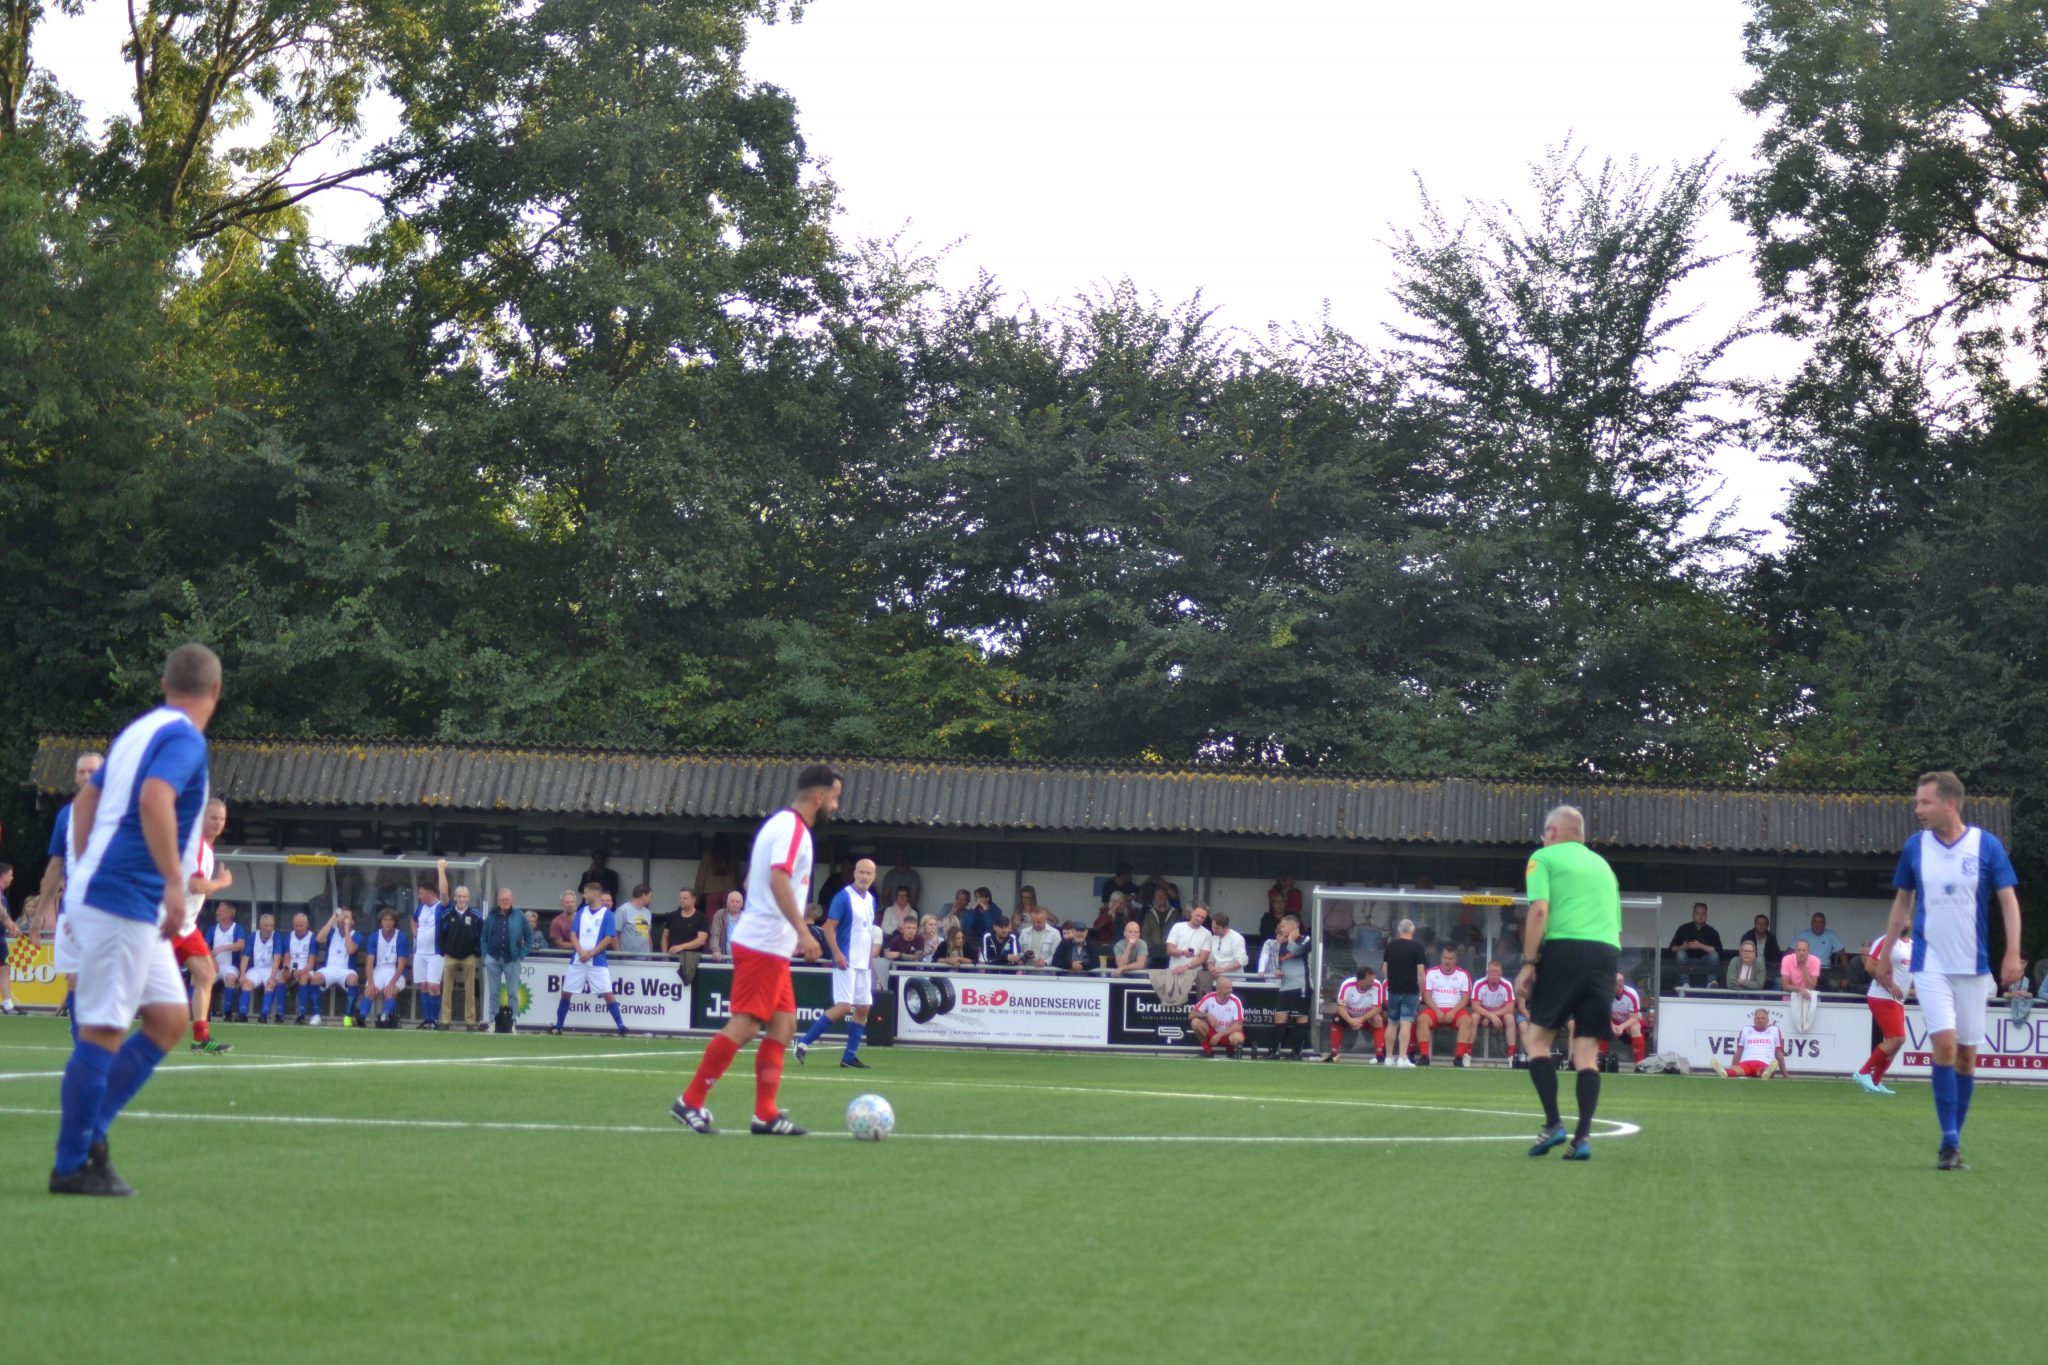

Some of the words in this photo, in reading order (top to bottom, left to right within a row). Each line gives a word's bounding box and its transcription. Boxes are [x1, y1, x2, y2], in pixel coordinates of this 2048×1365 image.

[612, 977, 635, 996] de
[640, 978, 683, 1002] Weg
[961, 988, 1009, 1007] B&O
[1009, 996, 1102, 1010] BANDENSERVICE
[568, 1001, 592, 1013] ank
[620, 1003, 666, 1016] arwash
